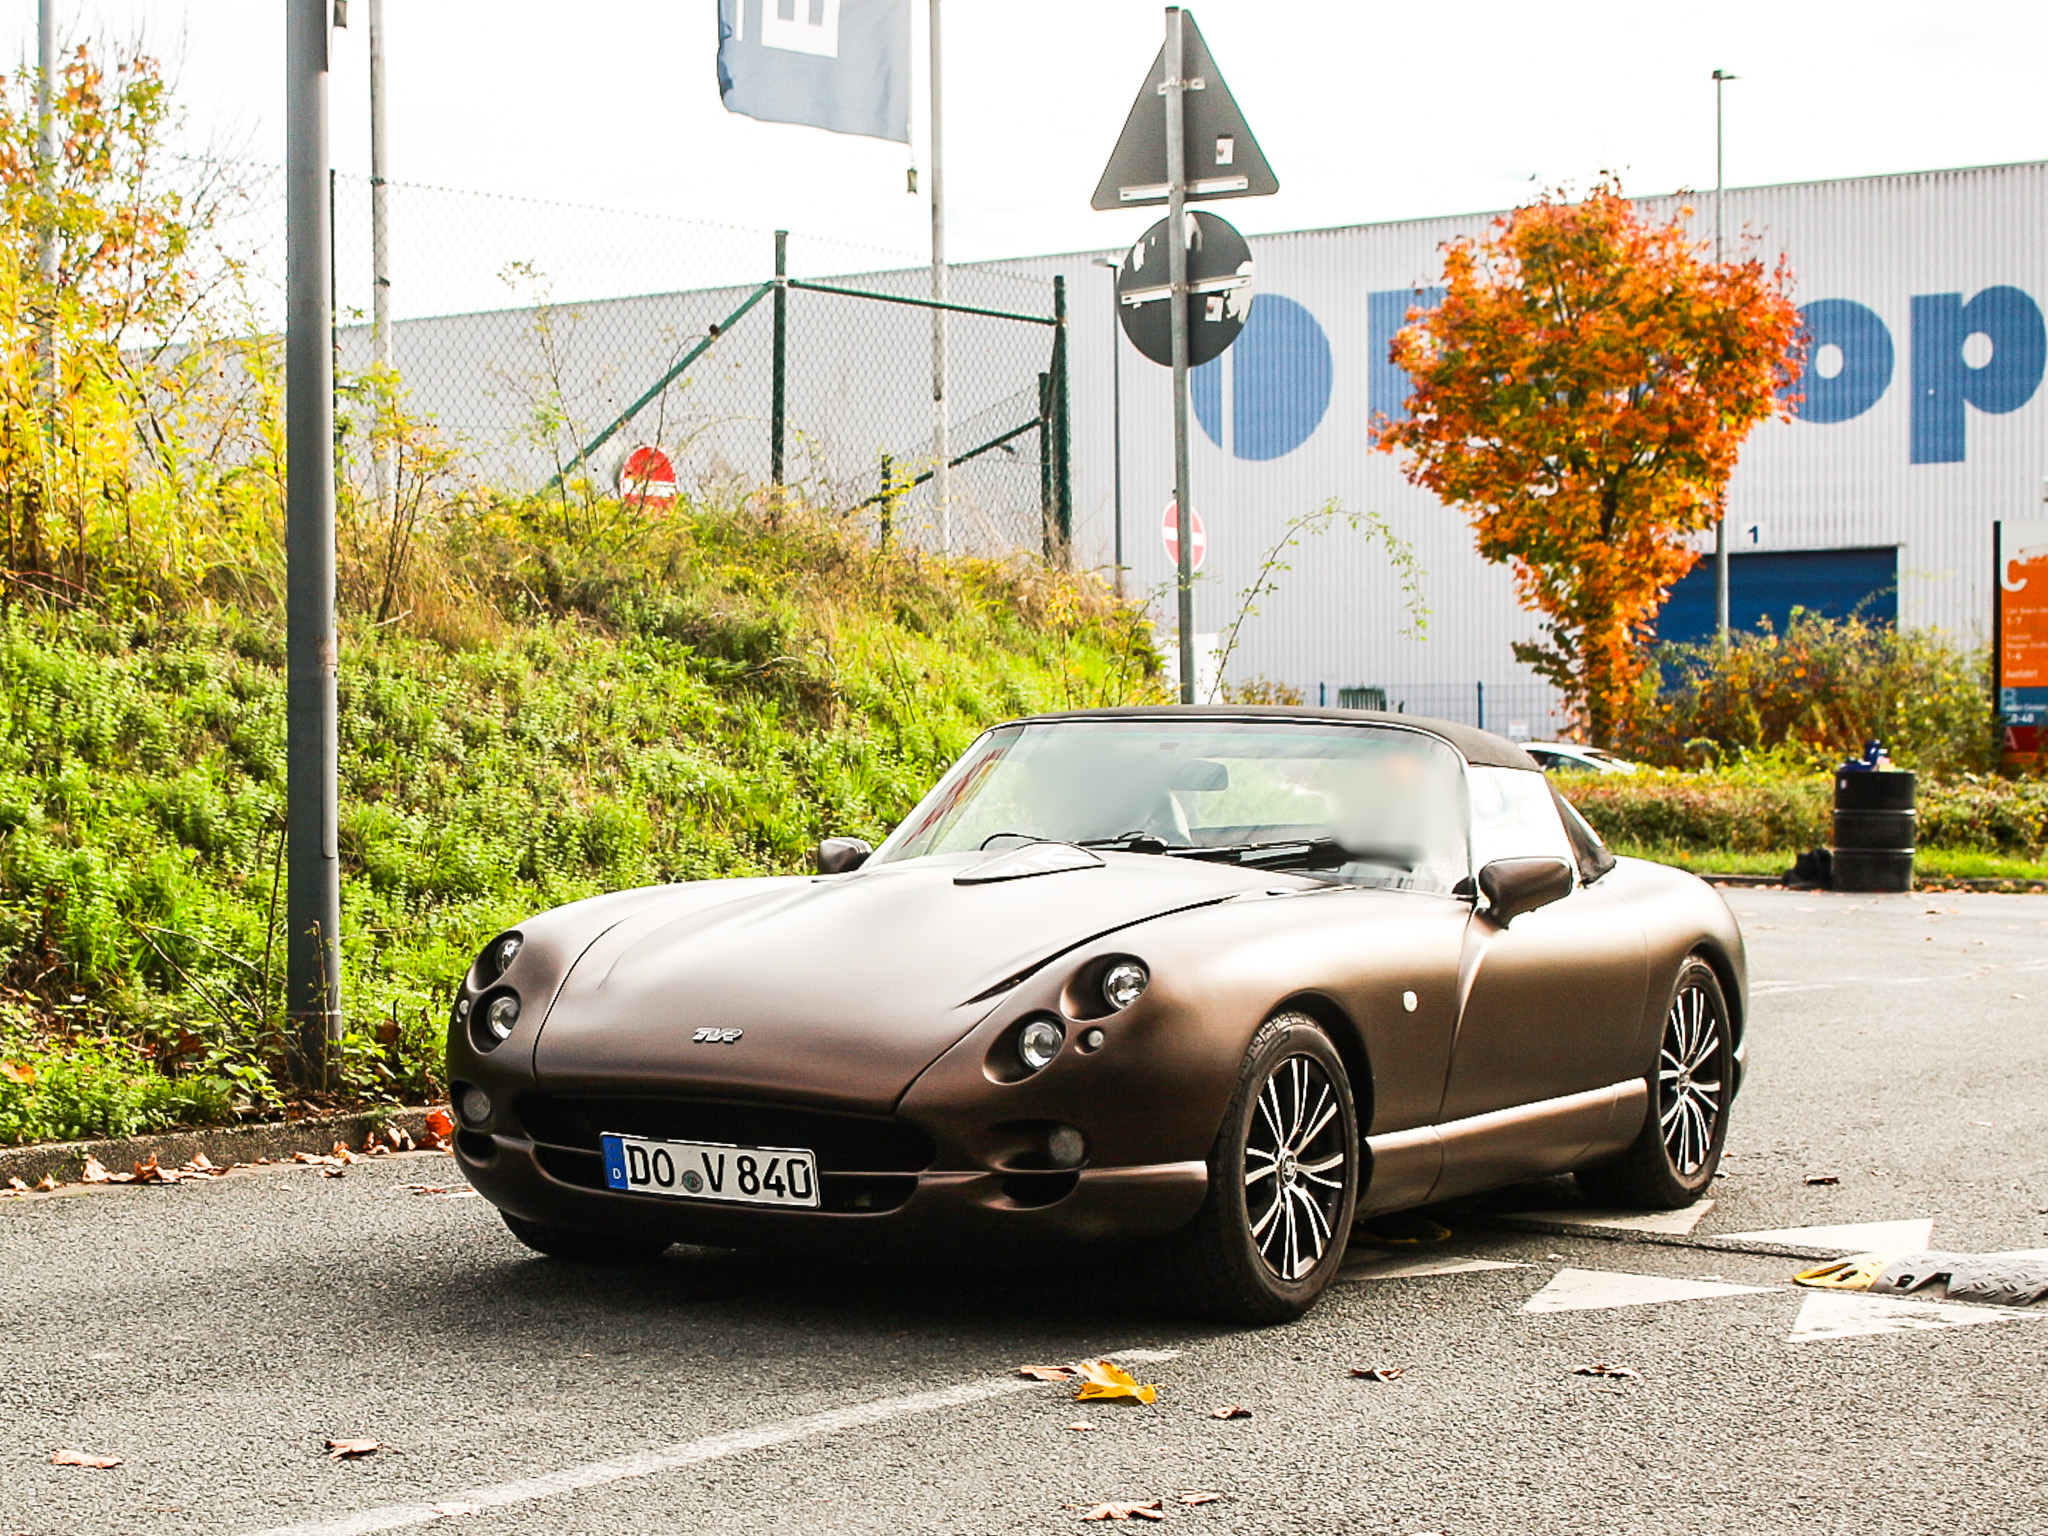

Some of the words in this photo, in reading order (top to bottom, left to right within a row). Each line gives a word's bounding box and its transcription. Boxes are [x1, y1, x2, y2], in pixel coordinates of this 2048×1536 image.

[1748, 525, 1758, 544] 1
[2003, 726, 2018, 750] A
[692, 1027, 744, 1044] TVR
[612, 1168, 621, 1180] D
[626, 1144, 675, 1187] DO
[701, 1152, 725, 1193] V
[736, 1155, 812, 1199] 840
